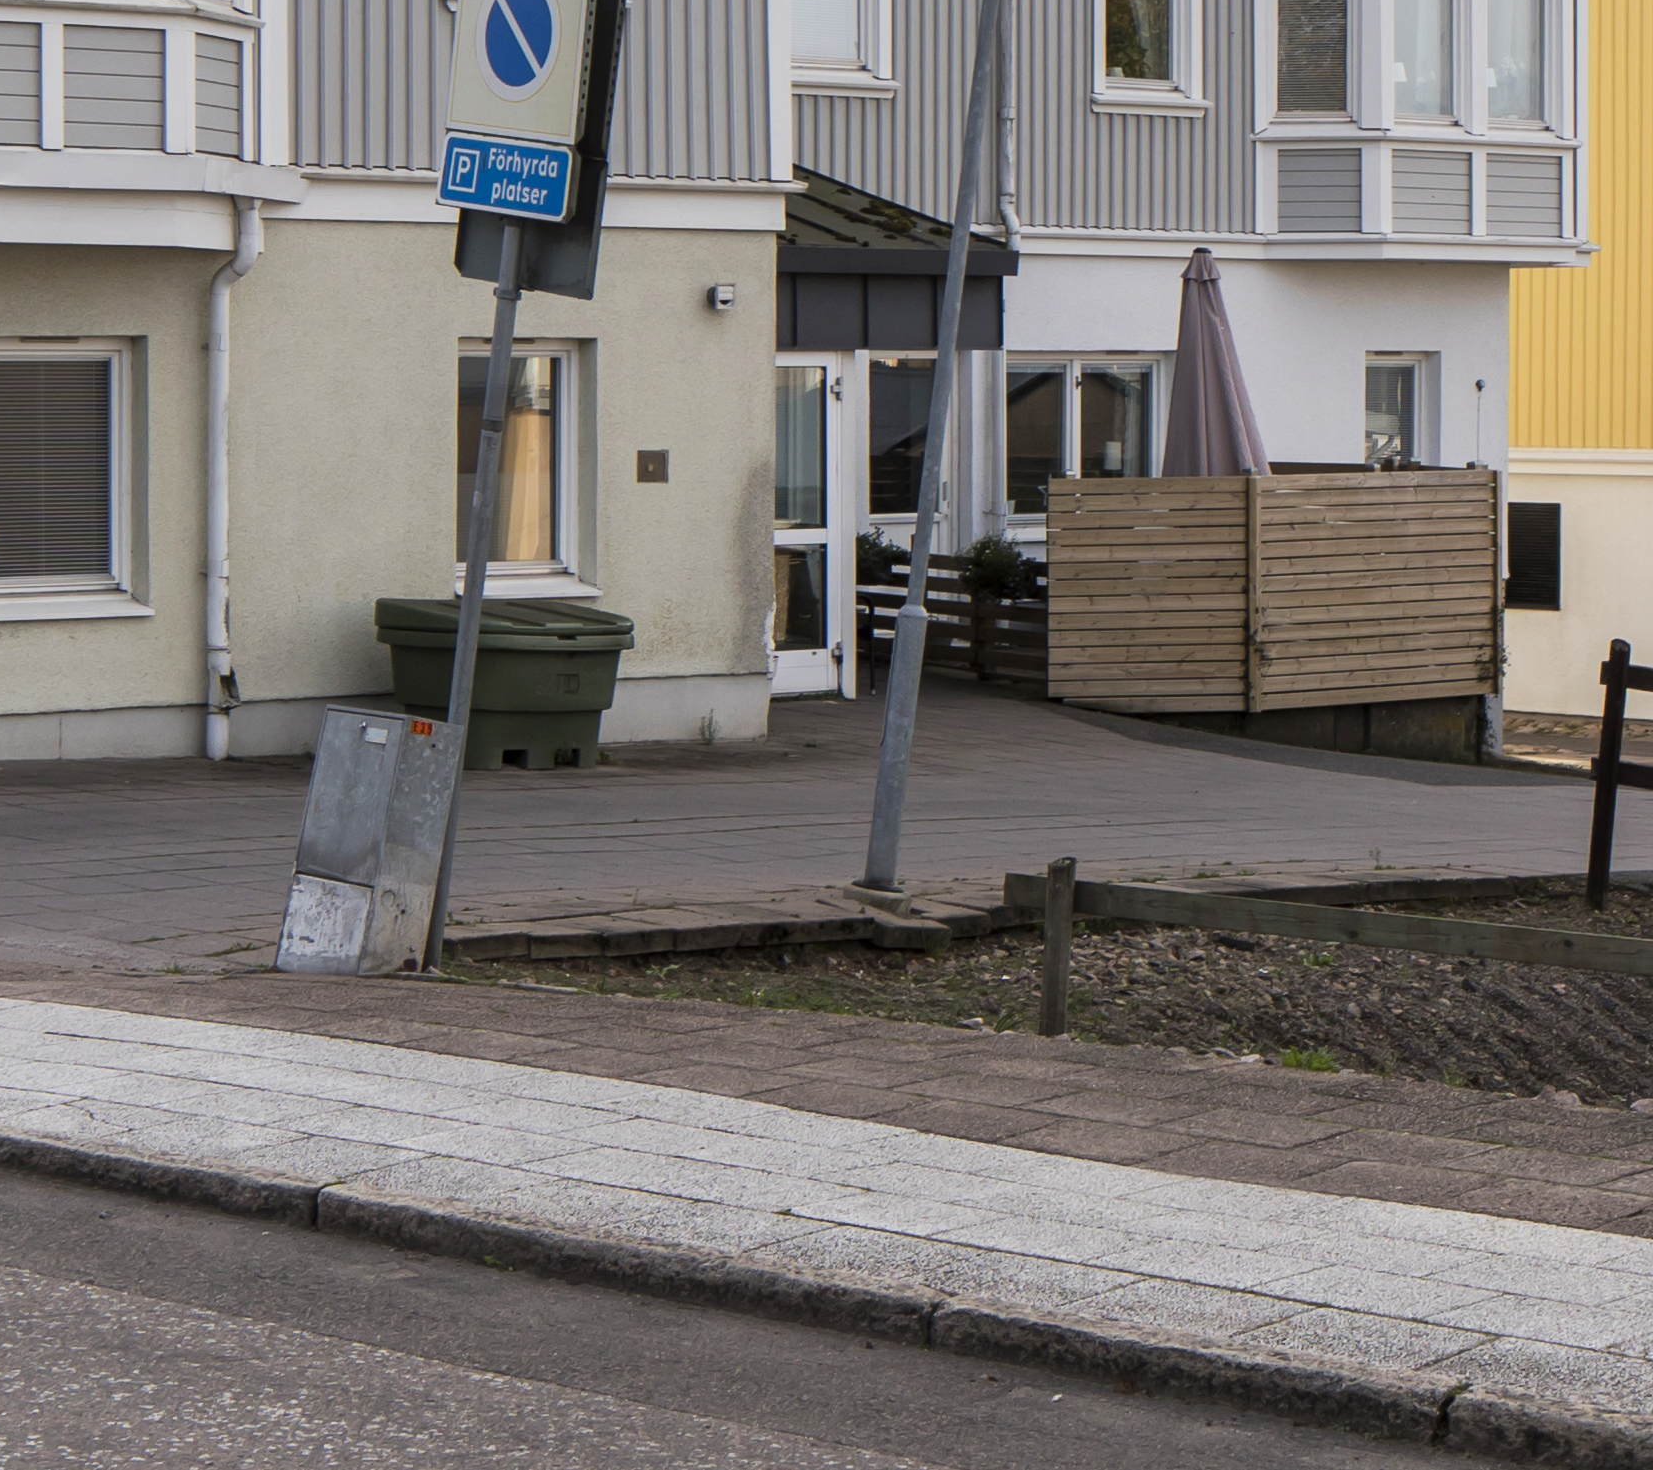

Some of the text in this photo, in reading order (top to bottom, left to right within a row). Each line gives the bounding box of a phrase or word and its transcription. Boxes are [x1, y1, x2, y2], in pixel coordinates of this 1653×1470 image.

[456, 155, 471, 183] P
[488, 147, 559, 179] Förhyrda
[491, 178, 548, 205] platser
